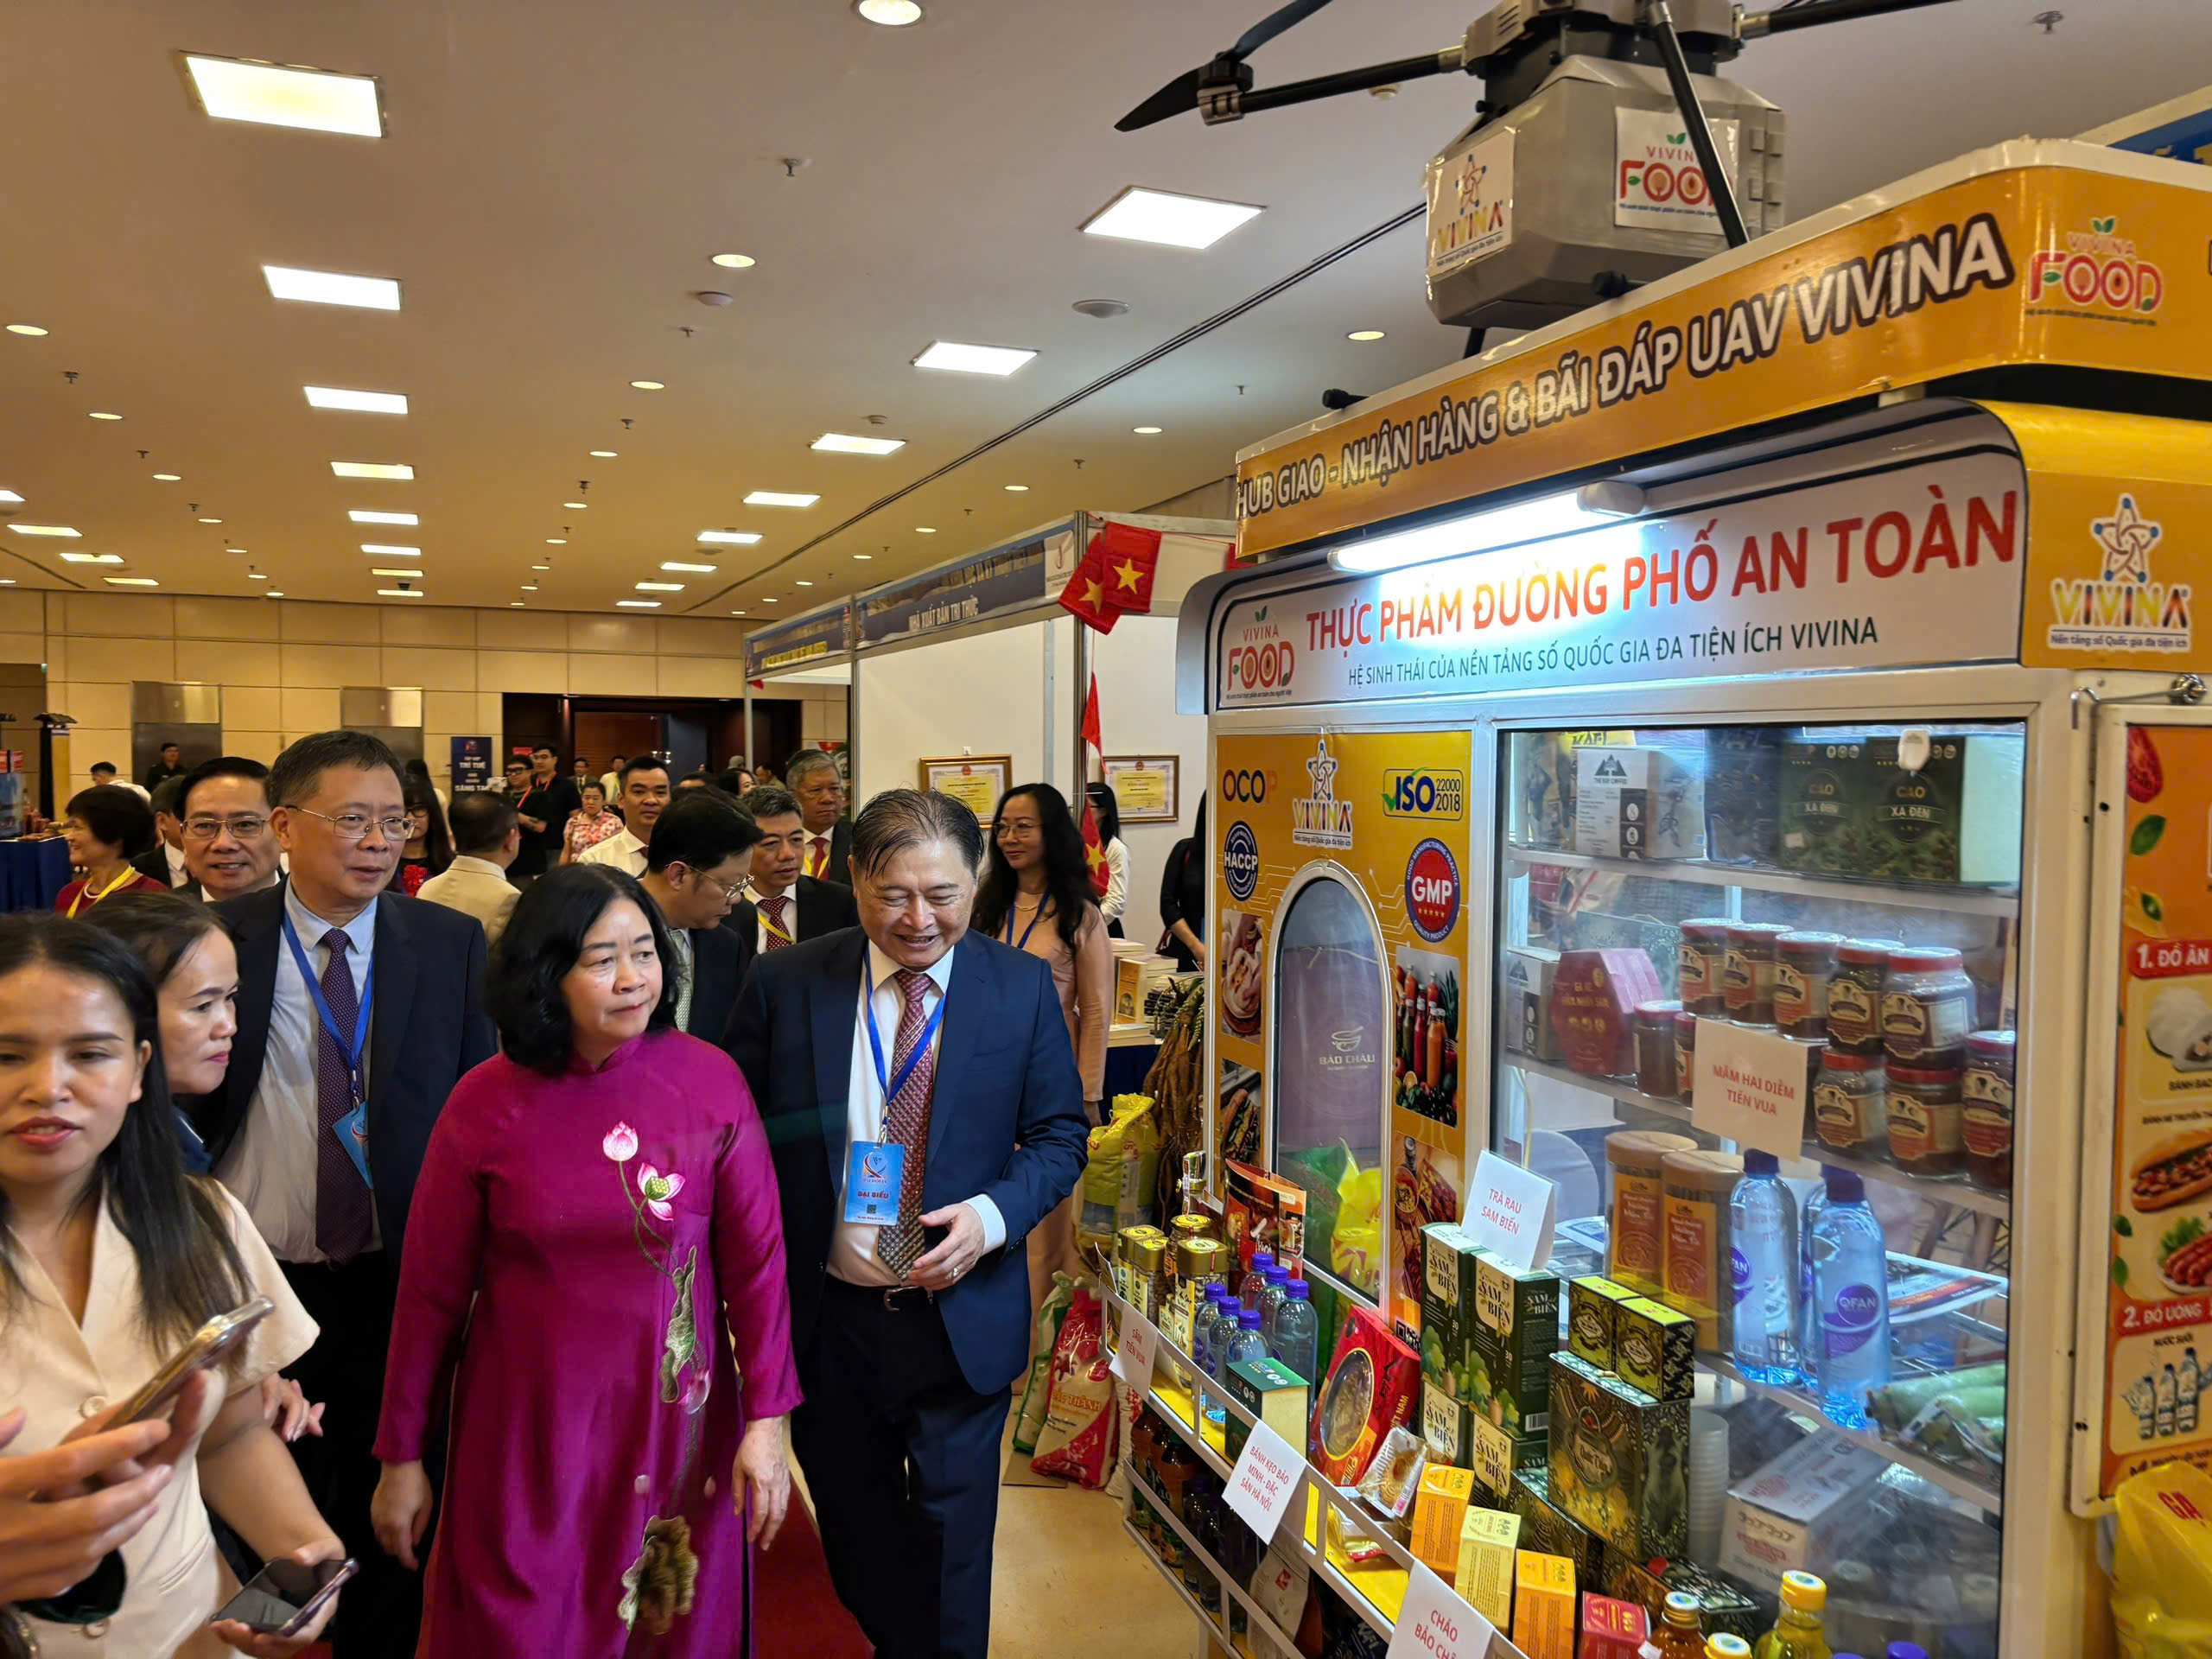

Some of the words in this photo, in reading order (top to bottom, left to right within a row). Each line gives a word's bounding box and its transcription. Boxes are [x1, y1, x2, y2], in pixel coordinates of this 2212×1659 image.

[1646, 145, 1695, 162] VIVIN
[1619, 159, 1719, 207] FOO
[1437, 201, 1503, 253] VIVINA
[2031, 252, 2163, 312] FOOD
[1236, 474, 1274, 518] HUB
[1278, 453, 1326, 506] GIAO
[1341, 416, 1411, 486] NHẬN
[1417, 393, 1498, 463] HÀNG
[1504, 384, 1533, 436] &
[1534, 352, 1592, 427] BÃI
[1599, 321, 1681, 407] ĐÁP
[1688, 284, 1789, 378] UAV
[1794, 213, 2015, 344] VIVINA
[1306, 598, 1372, 658] THỰC
[1624, 518, 1718, 610] PHỐ
[1731, 527, 1808, 596] AN
[1827, 484, 2017, 584] TOÀN
[2053, 582, 2188, 629] VIVINA
[1243, 625, 1279, 641] VIVINA
[1228, 641, 1294, 691] FOOD
[1349, 664, 1363, 689] HỆ
[1366, 664, 1393, 684] SINH
[1397, 658, 1424, 682] THÁI
[1428, 654, 1455, 678] CỦA
[1493, 647, 1532, 673] TẢNG
[1538, 640, 1558, 670] SỐ
[1564, 635, 1614, 671] QUỐC
[1620, 639, 1650, 664] GIA
[1656, 635, 1682, 661] ĐA
[1690, 627, 1736, 662] TIỆN
[1744, 623, 1782, 653] ÍCH
[1791, 617, 1878, 649] VIVINA
[1223, 769, 1278, 804] OCOP
[1395, 775, 1435, 812] ISO
[1435, 778, 1460, 792] 22000
[1435, 793, 1460, 812] 2018
[1294, 802, 1351, 832] VIVINA
[1224, 851, 1258, 871] HACCP
[1411, 875, 1452, 906] GMP
[2136, 943, 2154, 969] 1.
[2157, 942, 2183, 968] ĐỒ
[1754, 1097, 1777, 1116] VUA
[1481, 1206, 1499, 1224] SAM
[1490, 1188, 1503, 1205] TRÀ
[1504, 1197, 1522, 1214] RAU
[2122, 1306, 2141, 1328] 2.
[1395, 1395, 1409, 1415] NAM
[1248, 1464, 1264, 1484] MINH
[1250, 1446, 1266, 1465] BÁNH
[1276, 1469, 1289, 1484] BẢO
[1251, 1487, 1262, 1501] HÀ
[1414, 1623, 1434, 1649] BẢO
